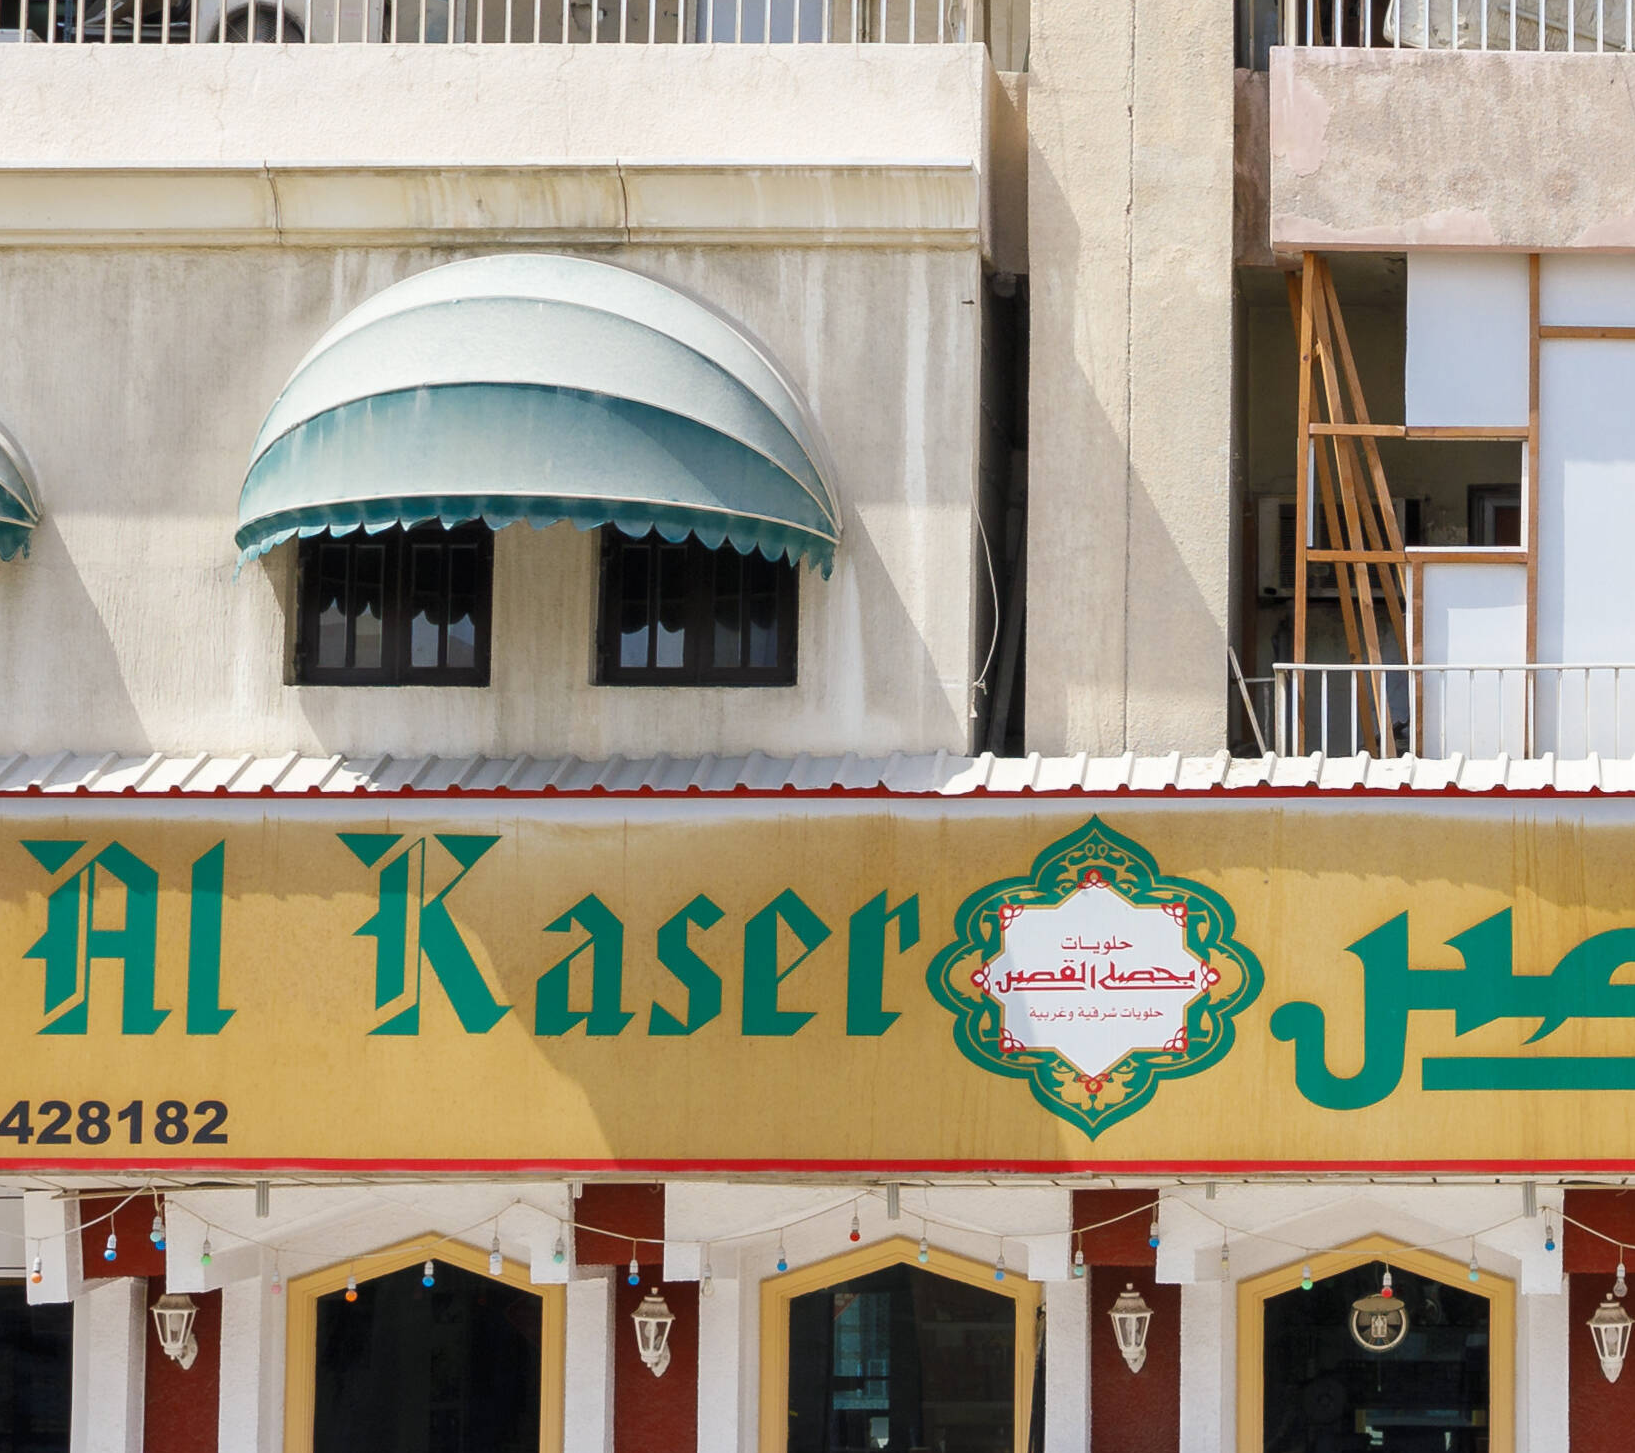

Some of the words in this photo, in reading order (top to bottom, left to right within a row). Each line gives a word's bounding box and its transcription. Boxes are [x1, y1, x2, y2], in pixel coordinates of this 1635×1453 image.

[22, 839, 238, 1036] Al
[334, 832, 921, 1037] Kaser
[1060, 934, 1134, 956] حلويات
[1077, 1005, 1118, 1022] شرقية
[1119, 1006, 1164, 1021] حلويات
